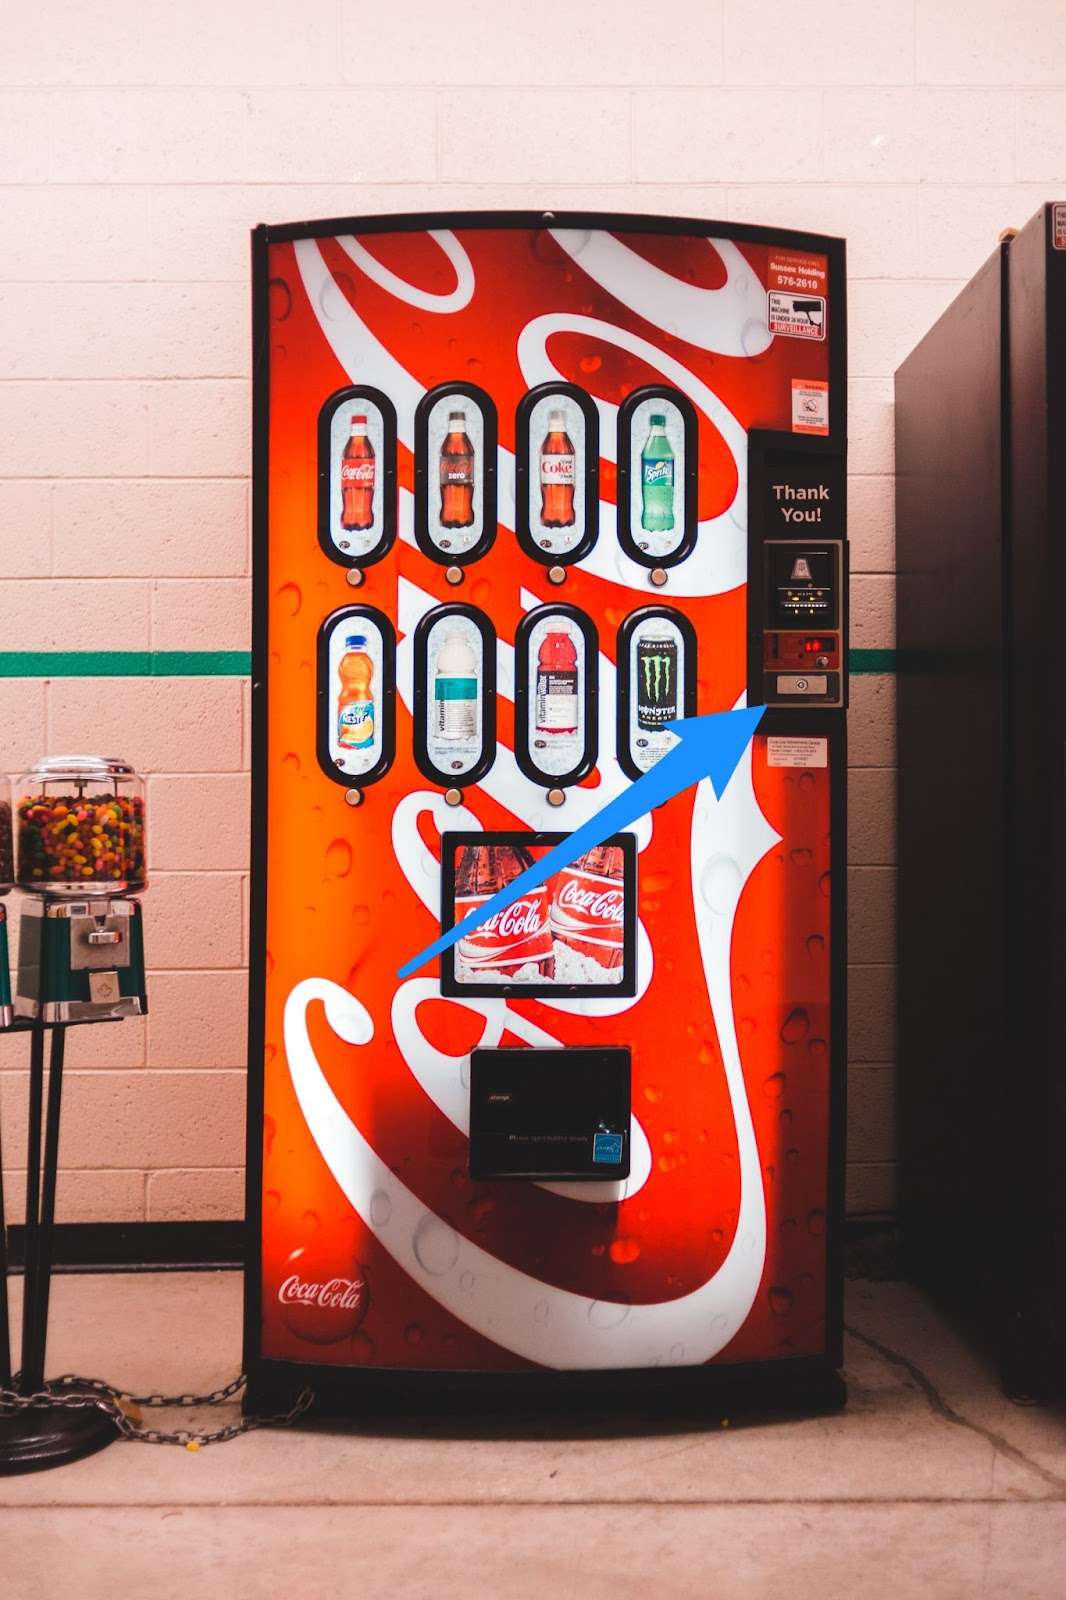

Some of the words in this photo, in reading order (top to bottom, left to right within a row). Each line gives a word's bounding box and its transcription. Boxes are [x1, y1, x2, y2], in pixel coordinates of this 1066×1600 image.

[798, 266, 826, 278] Holding
[777, 275, 818, 289] 576-2610
[773, 323, 819, 336] SURVEILLANCE
[542, 461, 572, 473] Coke
[647, 463, 673, 481] Sprite
[447, 471, 466, 480] zero
[772, 484, 830, 500] Thank
[780, 507, 822, 522] You!
[638, 705, 676, 716] MONSTER
[277, 1274, 365, 1310] Coca-Cola
